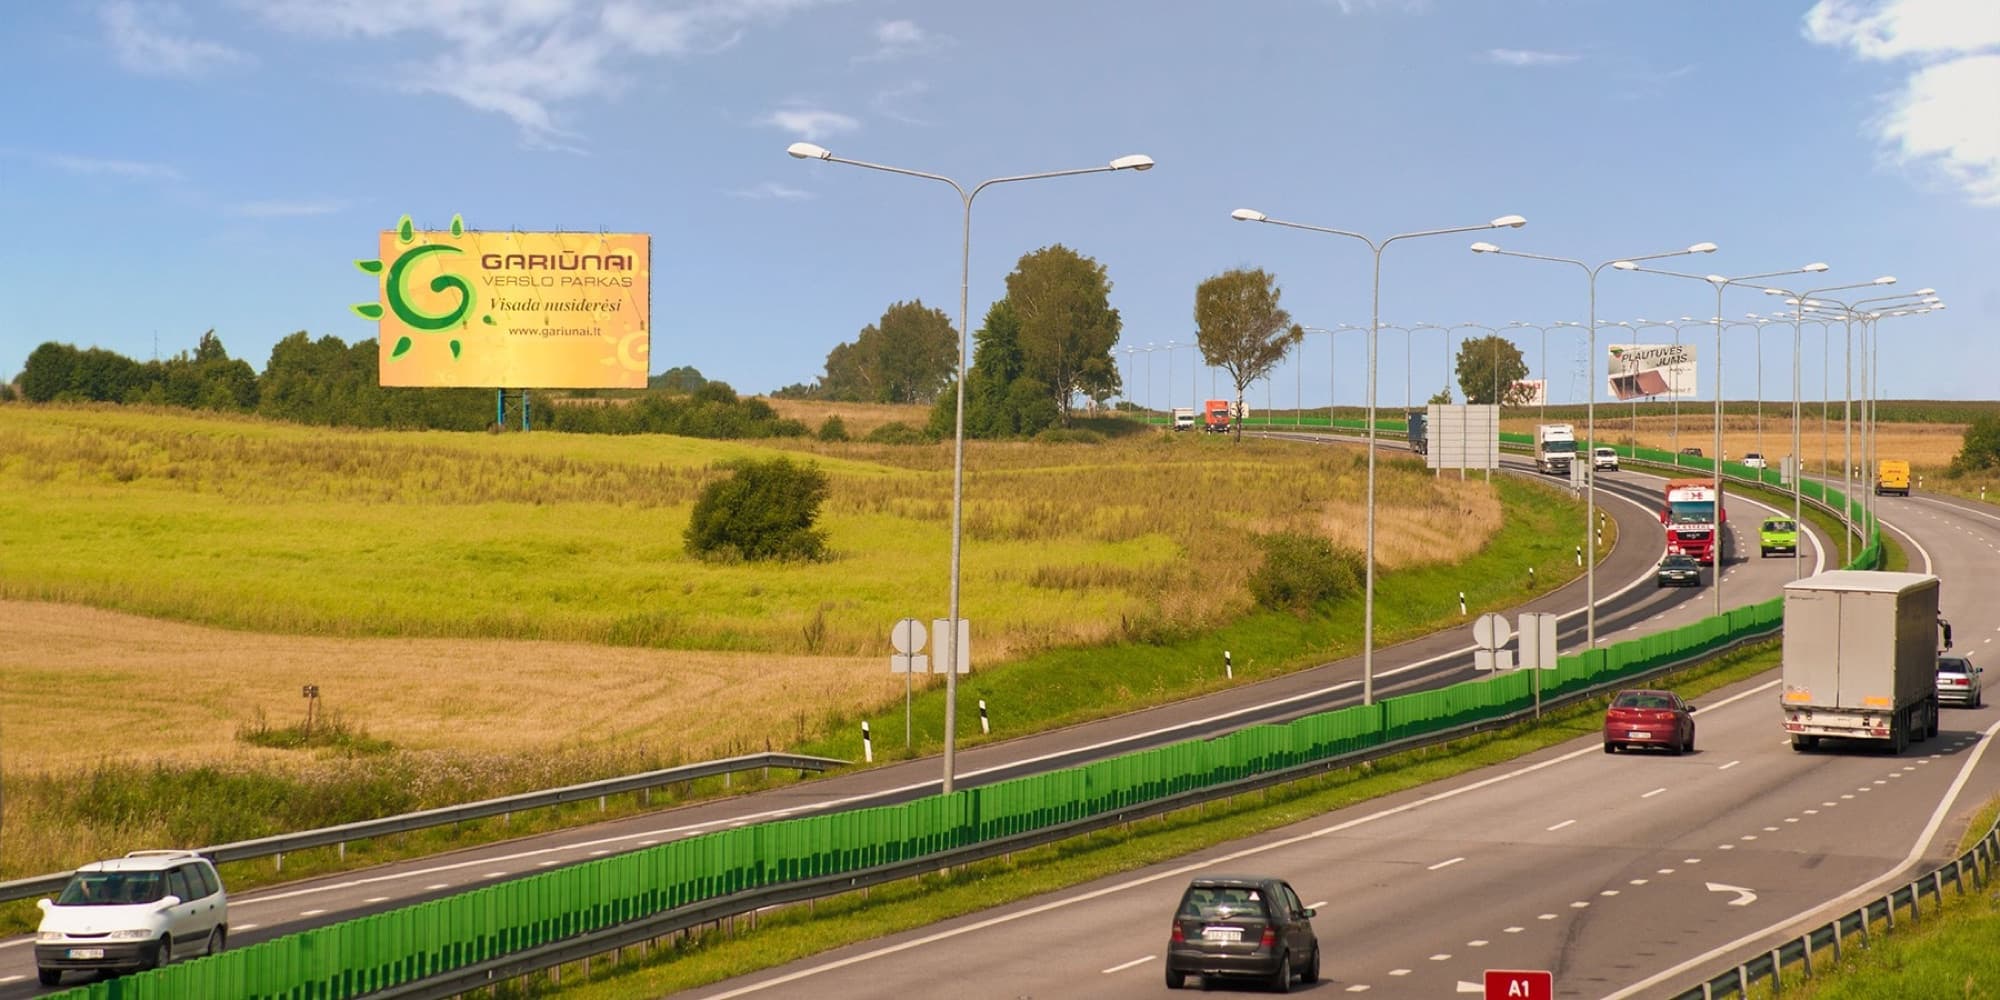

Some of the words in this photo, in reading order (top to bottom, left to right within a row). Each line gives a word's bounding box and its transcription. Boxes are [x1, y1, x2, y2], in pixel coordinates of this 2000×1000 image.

[482, 251, 633, 270] GARIŪNAI
[483, 276, 554, 287] VERSLO
[561, 277, 633, 287] PARKAS
[491, 298, 540, 311] Visada
[509, 327, 601, 337] www.gariunai.lt
[1656, 354, 1687, 367] JUMS
[1508, 980, 1529, 997] A1
